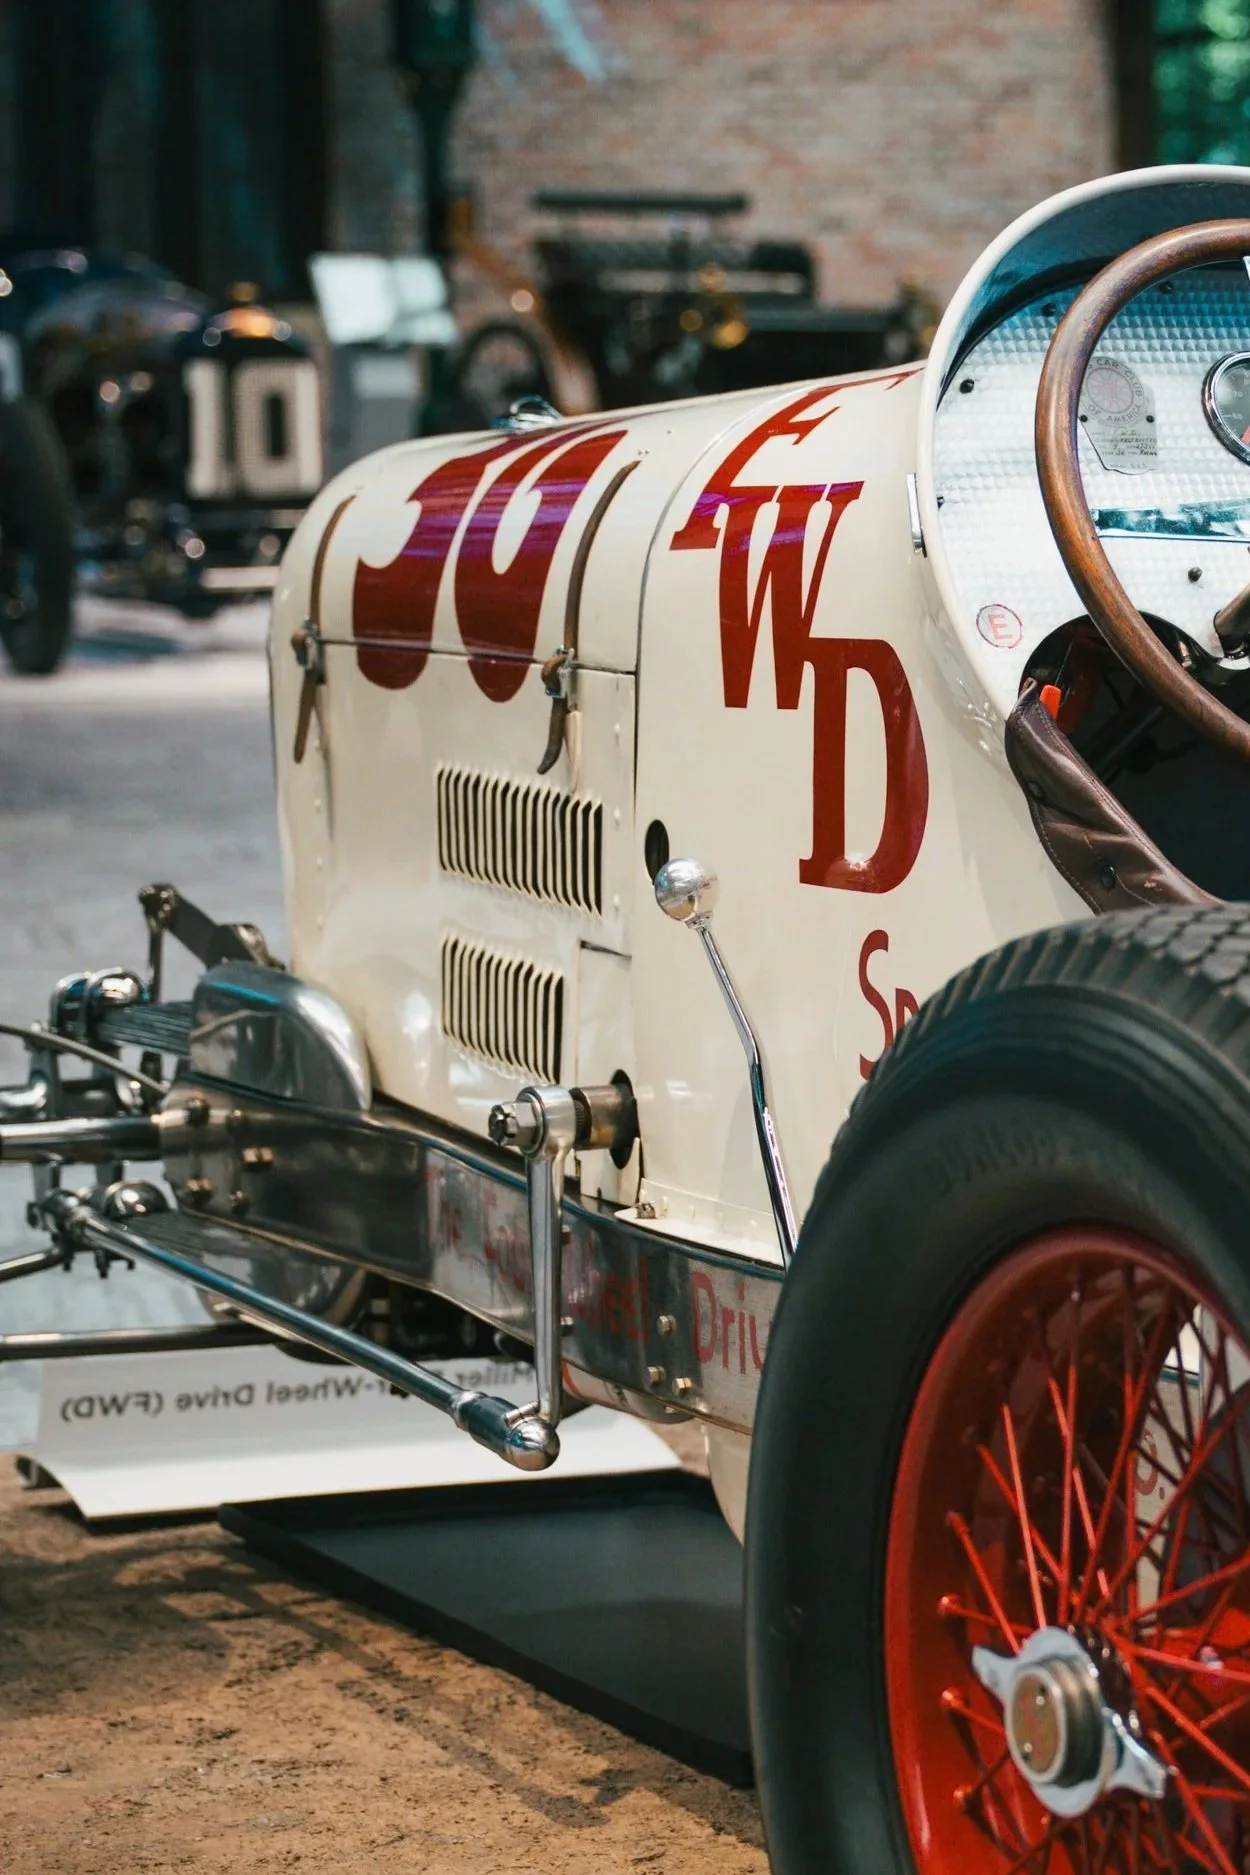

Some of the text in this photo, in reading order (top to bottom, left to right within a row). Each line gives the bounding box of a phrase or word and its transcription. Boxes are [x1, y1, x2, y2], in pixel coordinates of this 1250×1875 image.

[1096, 359, 1143, 397] CAR CLUB
[182, 358, 322, 499] 10
[1106, 403, 1141, 422] AMERICA
[987, 613, 1013, 640] E
